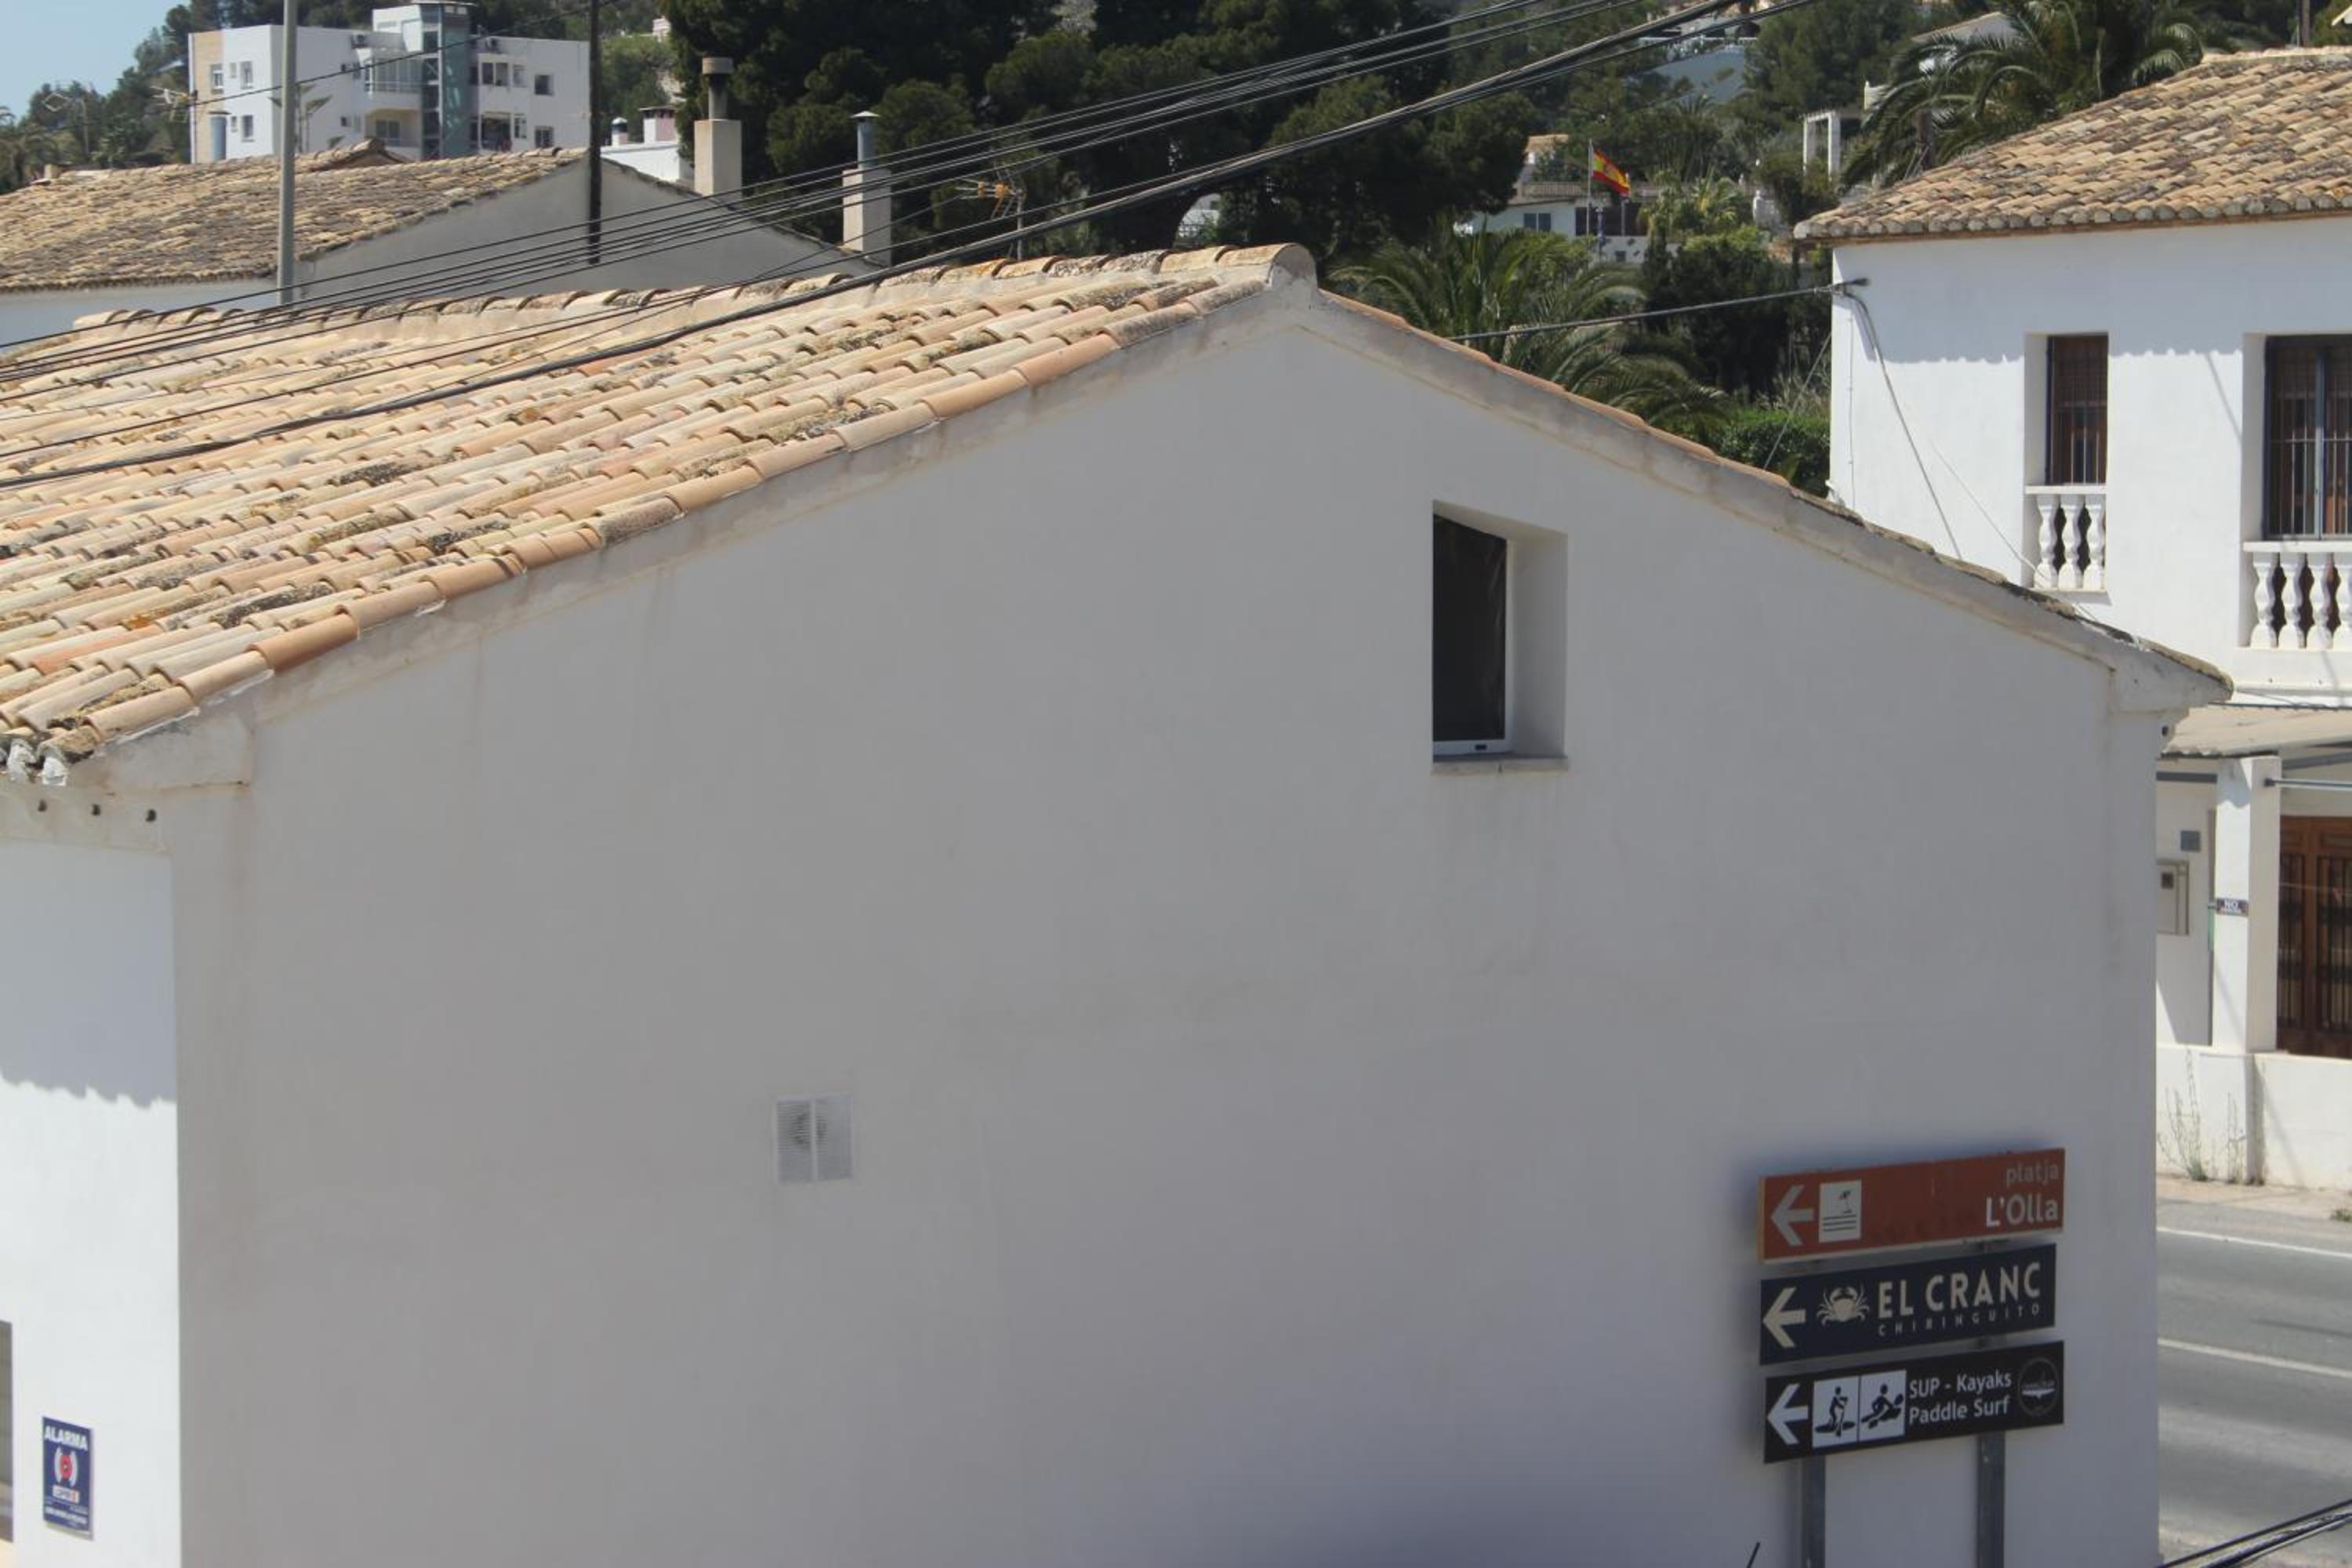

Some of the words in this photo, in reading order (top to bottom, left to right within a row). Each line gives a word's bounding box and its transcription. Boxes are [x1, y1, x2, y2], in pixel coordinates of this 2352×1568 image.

[2006, 1160, 2059, 1189] platja
[1985, 1192, 2059, 1229] L'Olla
[1878, 1280, 1915, 1319] EL
[1926, 1261, 2041, 1312] CRANC
[1909, 1377, 1940, 1399] SUP
[1956, 1369, 2013, 1395] Kayaks
[1909, 1400, 1969, 1425] Paddle
[1973, 1394, 2011, 1417] Surf
[44, 1425, 89, 1451] ALARMA
